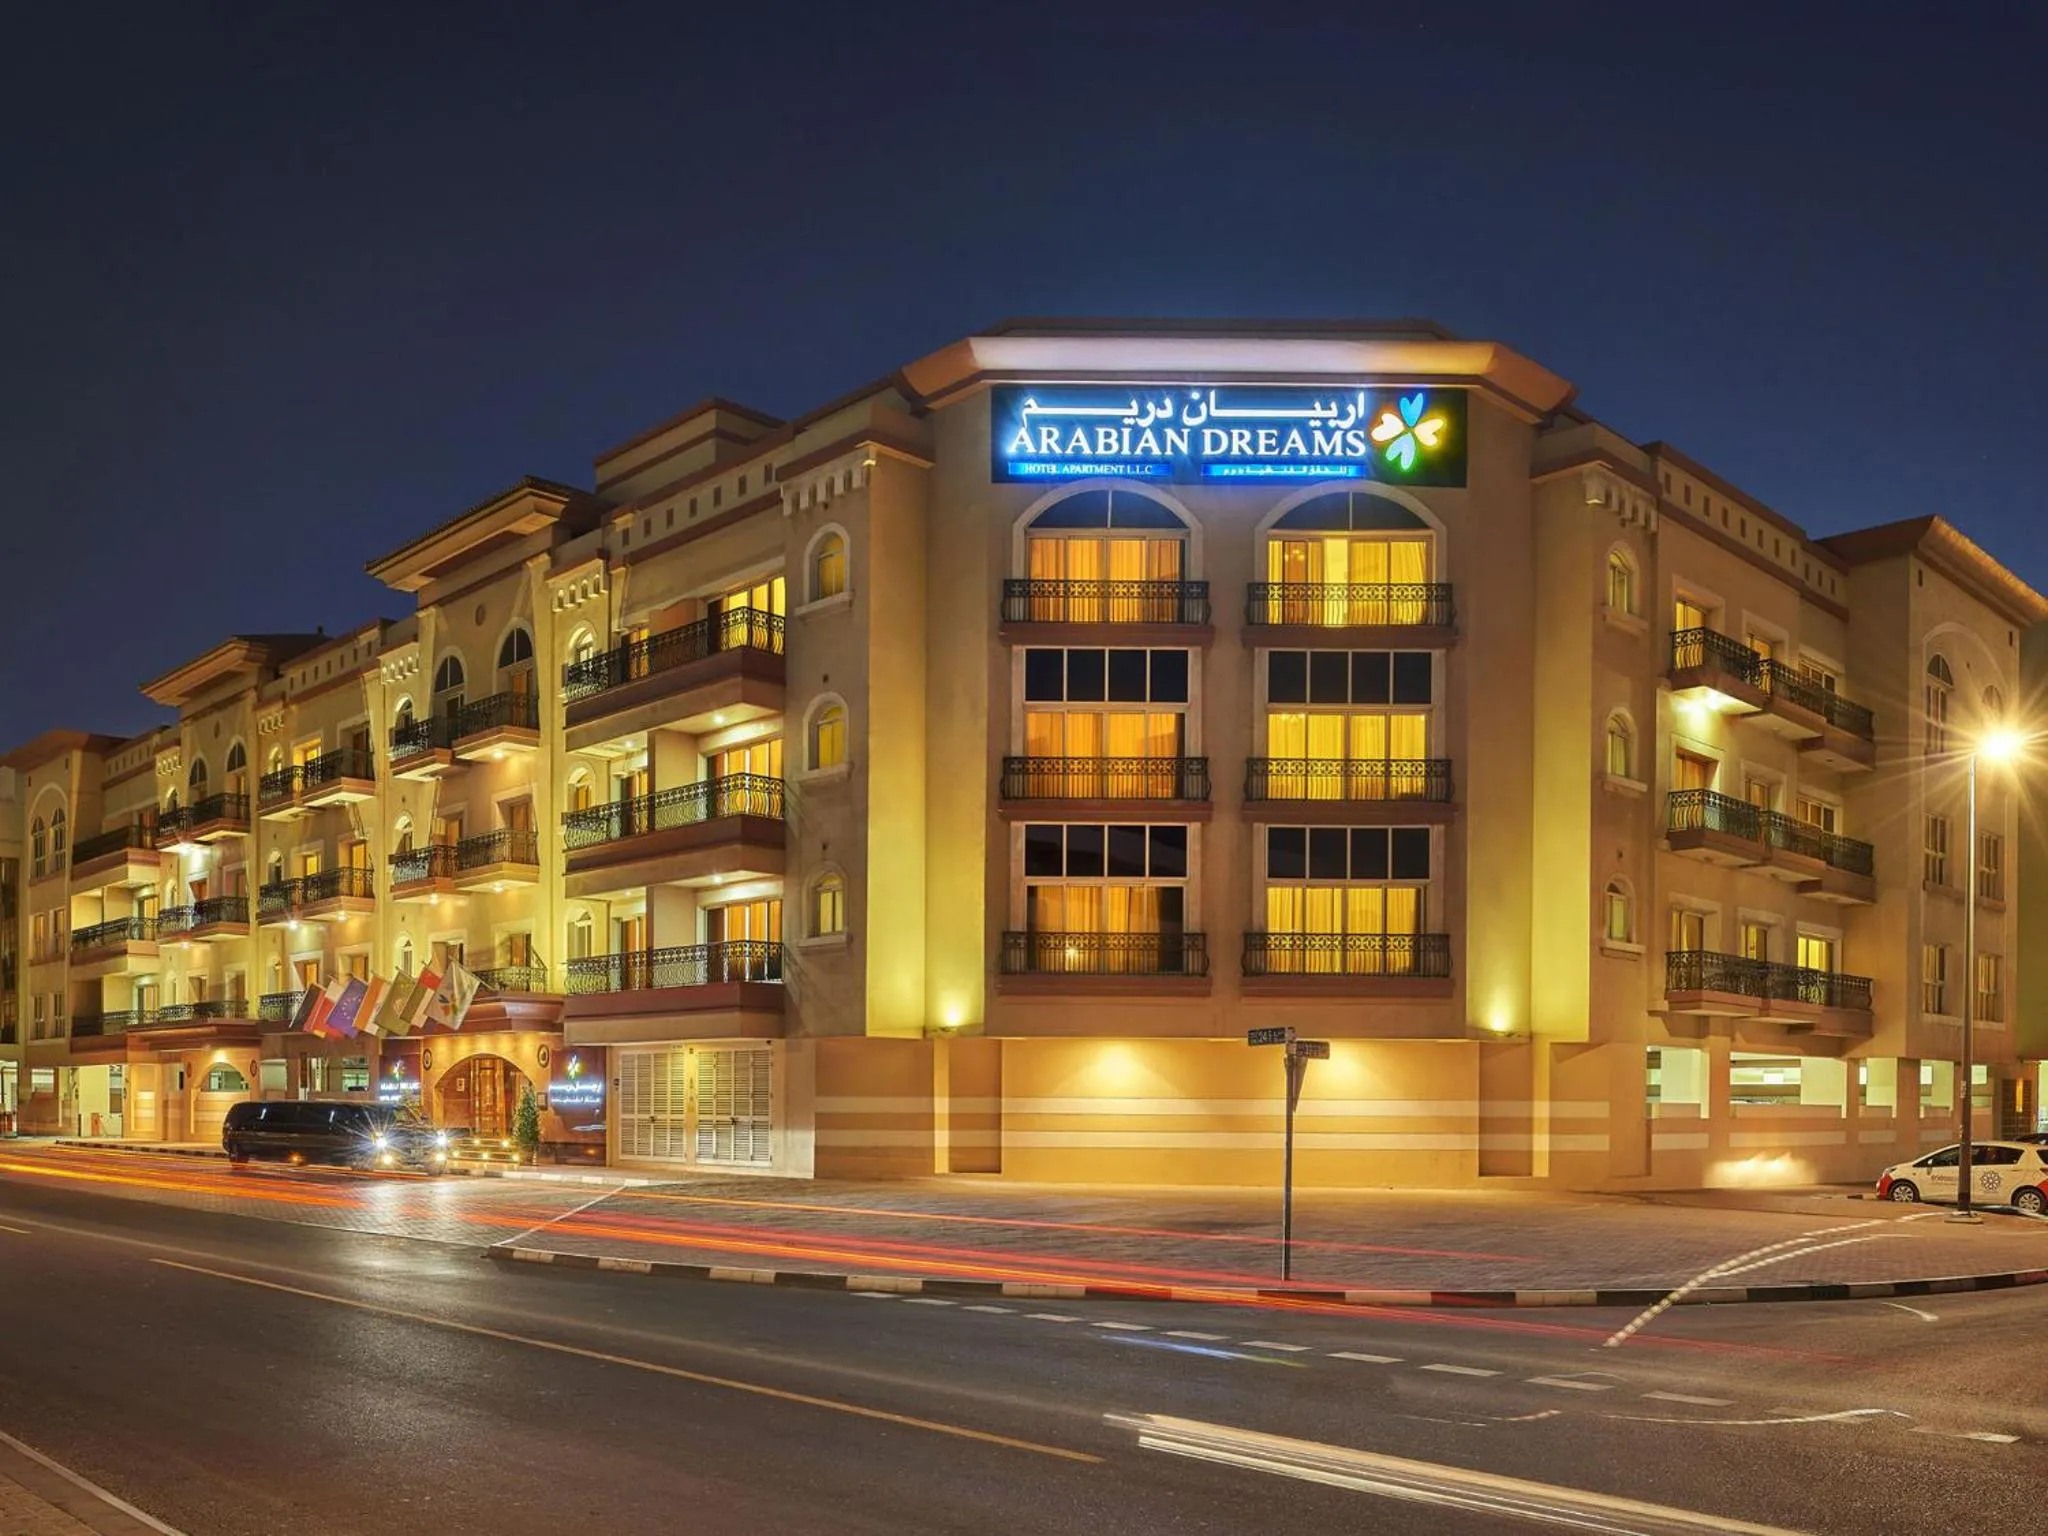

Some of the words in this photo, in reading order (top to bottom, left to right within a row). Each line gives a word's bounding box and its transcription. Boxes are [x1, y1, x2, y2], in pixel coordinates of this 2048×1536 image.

[1008, 427, 1191, 456] ARABIAN
[1202, 427, 1367, 457] DREAMS
[1025, 463, 1060, 475] HOTEL
[1062, 464, 1125, 475] APARTMENT
